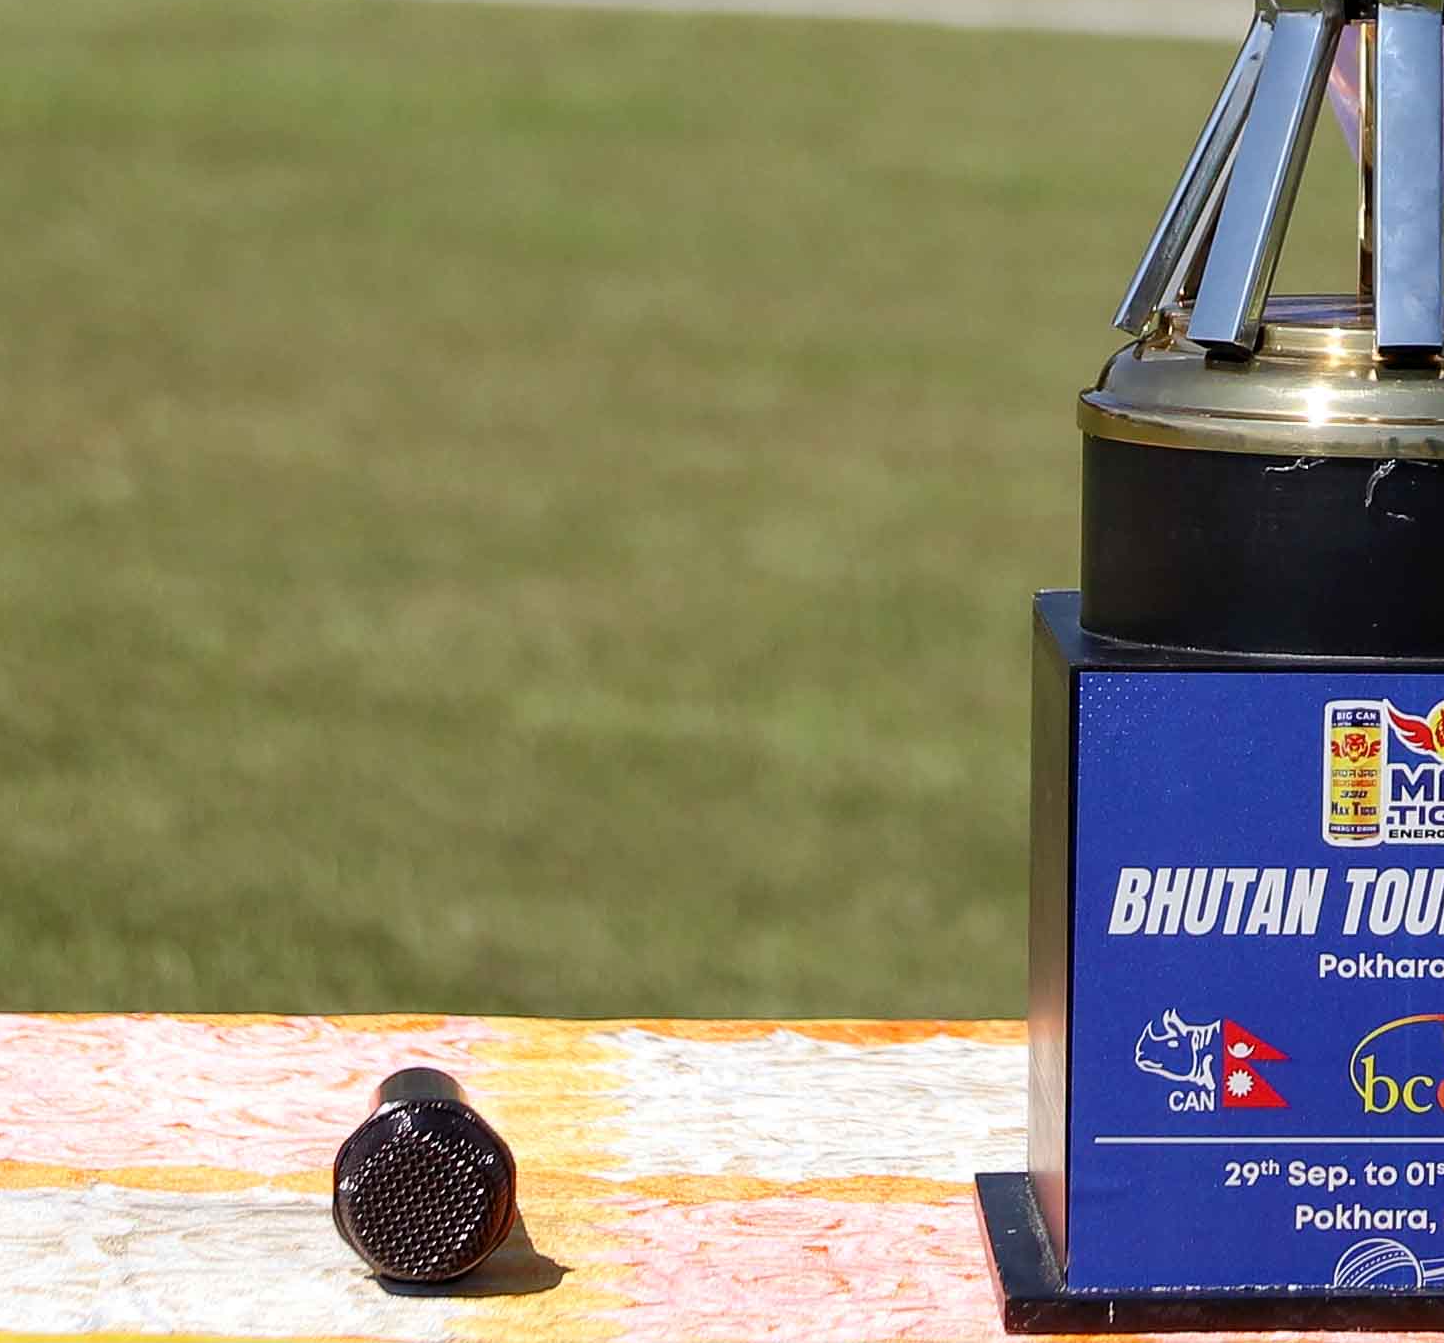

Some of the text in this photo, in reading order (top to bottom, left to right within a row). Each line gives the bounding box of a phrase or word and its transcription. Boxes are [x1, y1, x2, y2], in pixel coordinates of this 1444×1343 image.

[1108, 867, 1328, 937] BHUTAN
[1169, 1090, 1216, 1111] CAN
[1224, 1159, 1280, 1186] 29th
[1288, 1161, 1356, 1192] Sep.
[1364, 1163, 1398, 1186] to
[1295, 1203, 1437, 1234] Pokhara,
